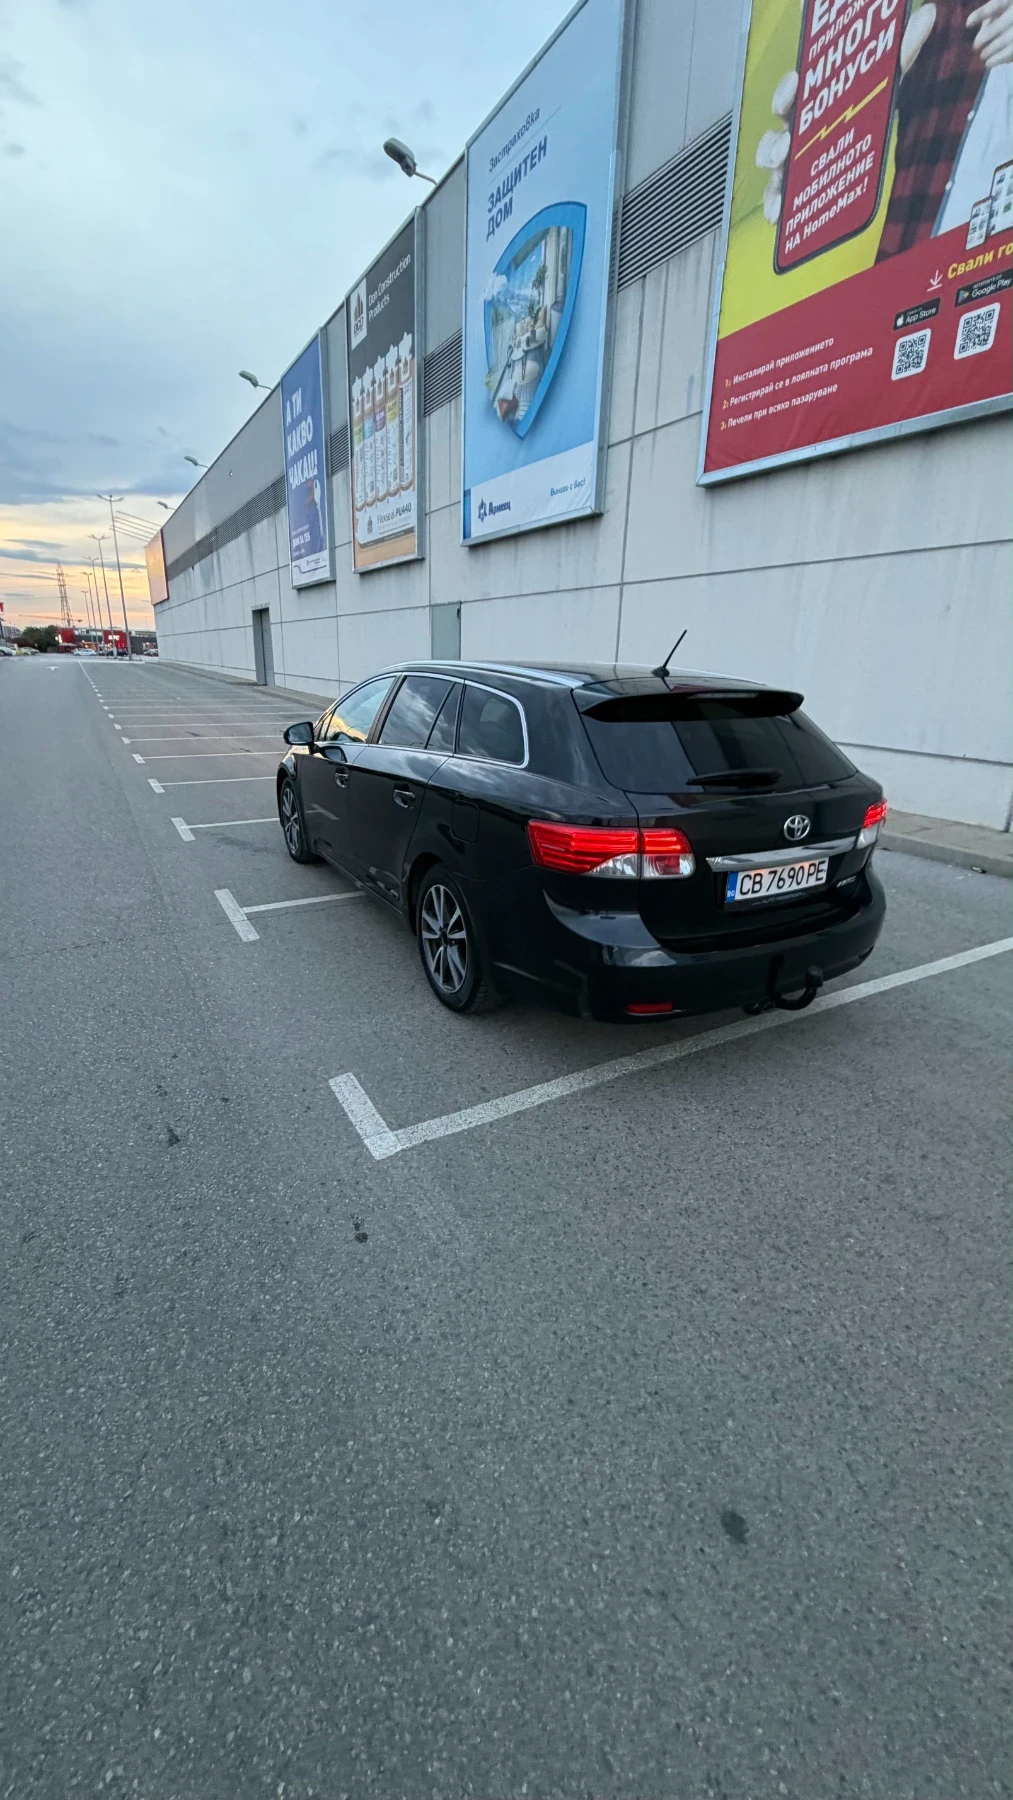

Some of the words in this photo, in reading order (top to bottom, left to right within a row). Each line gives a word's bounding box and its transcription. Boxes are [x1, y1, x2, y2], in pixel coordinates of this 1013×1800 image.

[809, 0, 868, 62] ПРИЛОЖ
[798, 17, 897, 135] БОНУСИ
[489, 108, 540, 173] Застраховка
[810, 127, 855, 177] СВАЛИ
[487, 134, 548, 214] ЗАЩИТЕН
[785, 150, 875, 237] ПРИЛОЖЕНИЕ
[793, 134, 872, 211] МОБИЛНОТО
[486, 196, 513, 242] ДОМ
[785, 232, 801, 254] НА
[803, 176, 869, 240] HomeMax!
[378, 253, 411, 296] Construction
[947, 250, 994, 279] Свали
[971, 283, 997, 298] Google
[996, 277, 1012, 289] Play
[368, 293, 390, 322] Products
[905, 313, 919, 324] App
[920, 307, 937, 318] Store
[730, 382, 774, 407] Регистрирай
[774, 380, 784, 390] се
[785, 378, 790, 387] в
[790, 363, 829, 385] лоялната
[829, 347, 873, 370] програма
[733, 360, 775, 385] Инсталирай
[775, 337, 834, 368] приложението
[286, 400, 292, 427] А
[291, 387, 302, 420] ТИ
[728, 413, 753, 428] Печели
[753, 408, 768, 420] при
[768, 400, 790, 413] всяко
[791, 384, 838, 407] пазаруване
[287, 415, 313, 459] КАКВО
[727, 889, 736, 898] BG
[765, 865, 805, 892] 7690
